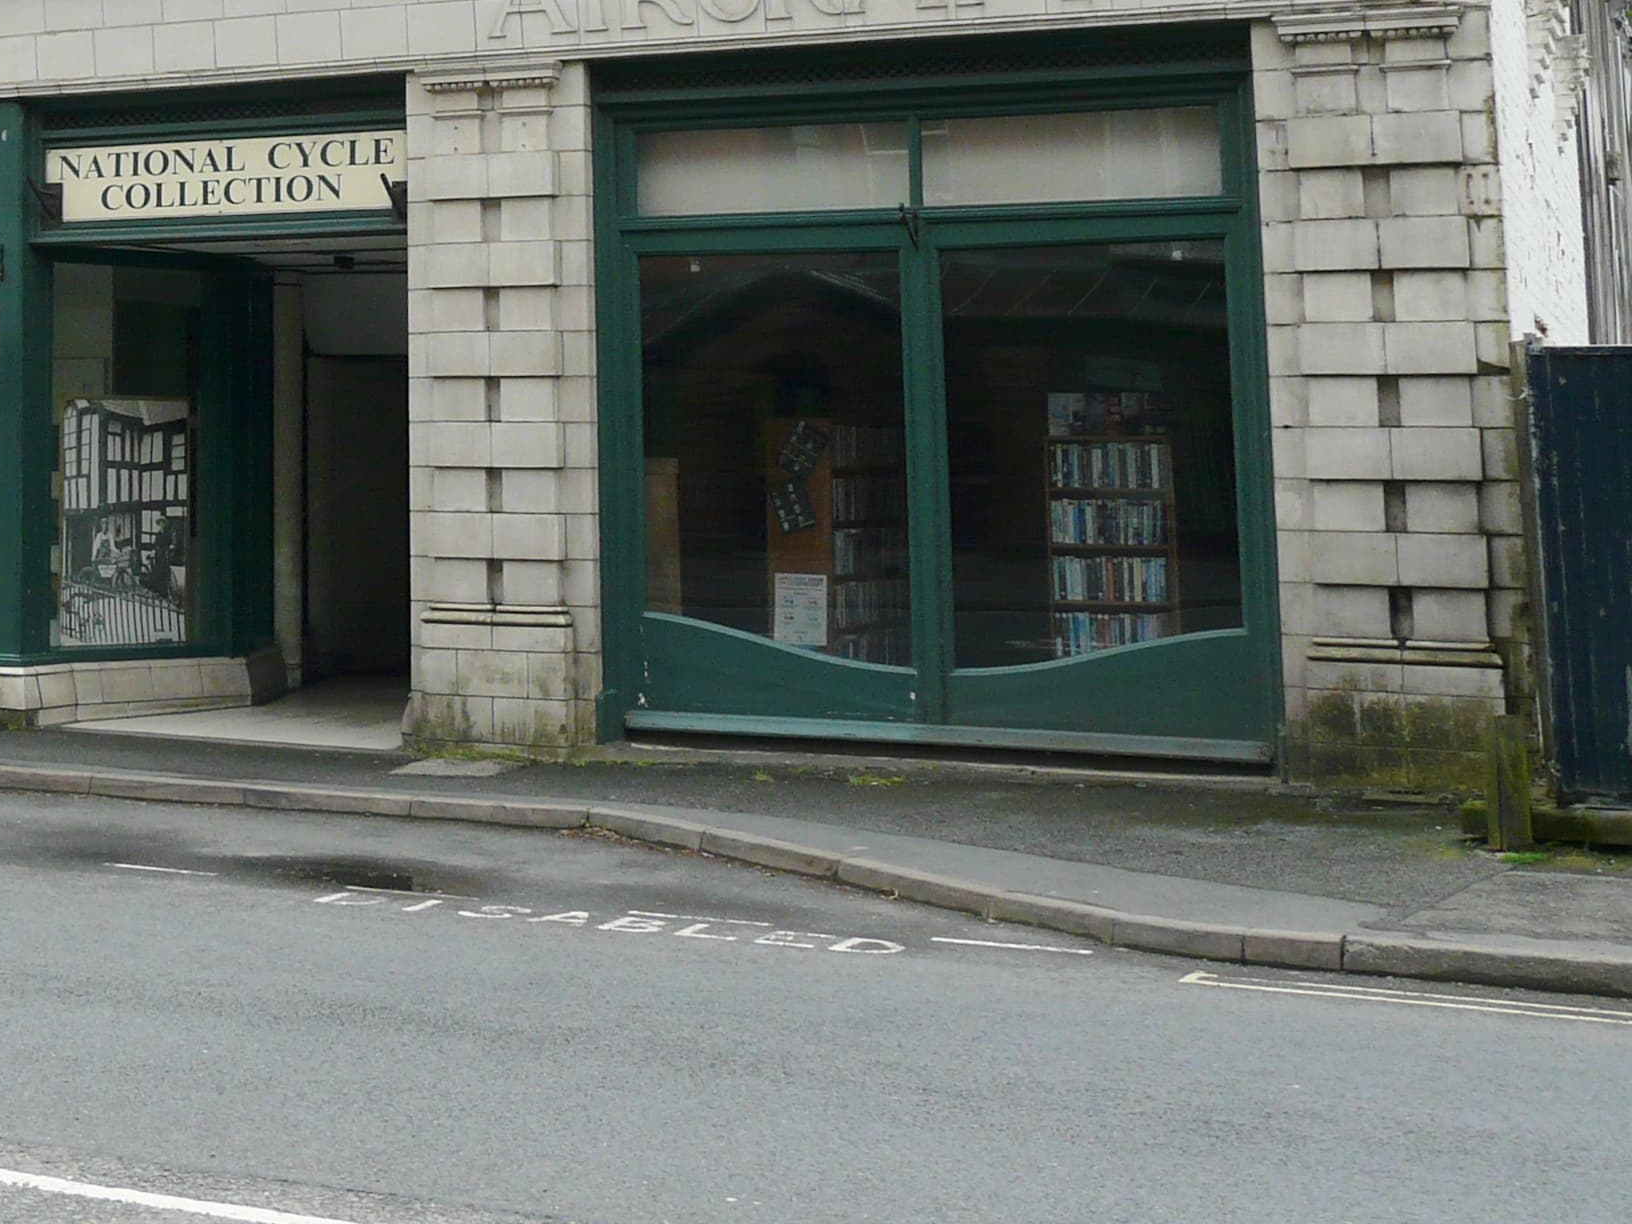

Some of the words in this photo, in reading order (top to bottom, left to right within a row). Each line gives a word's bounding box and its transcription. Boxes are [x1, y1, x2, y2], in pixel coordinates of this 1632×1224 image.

[58, 145, 246, 181] NATIONAL
[267, 136, 396, 170] CYCLE
[100, 172, 343, 212] COLLECTION
[313, 890, 906, 955] DISABLED
